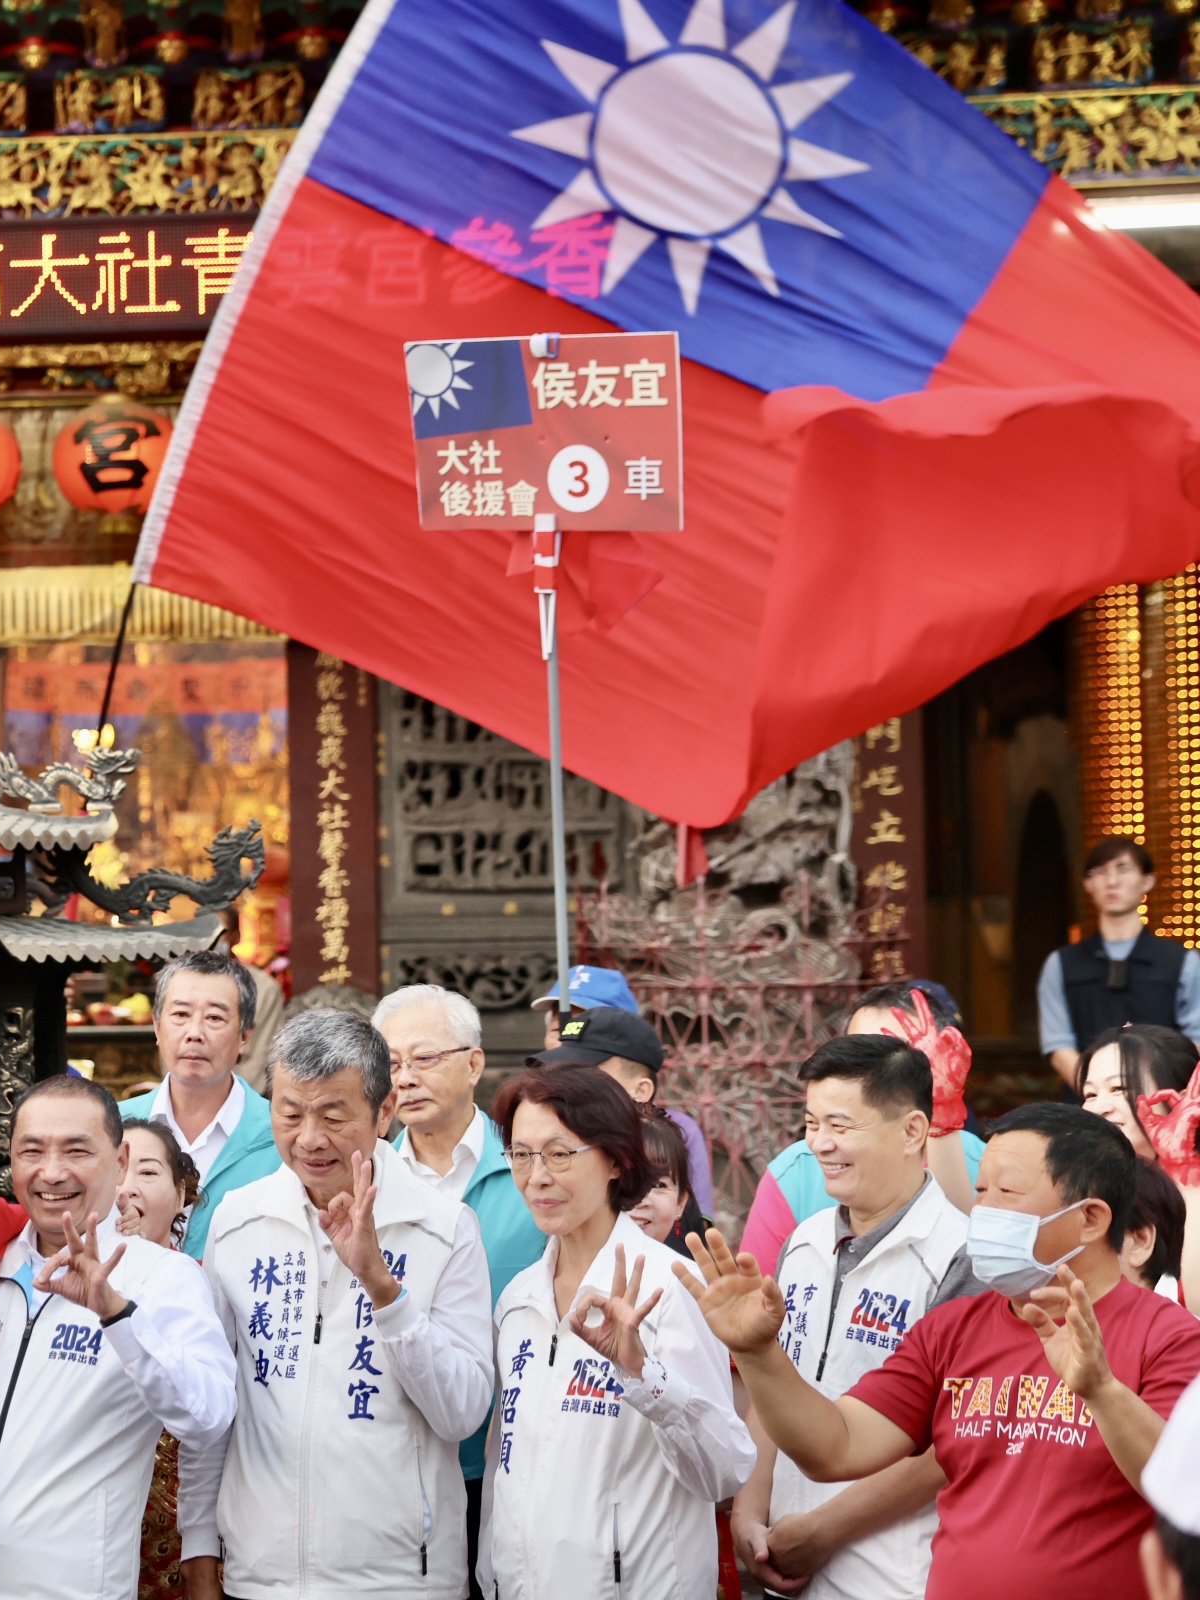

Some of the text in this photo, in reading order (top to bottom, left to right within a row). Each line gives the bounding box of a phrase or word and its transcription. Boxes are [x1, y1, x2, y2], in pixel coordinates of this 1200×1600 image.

[531, 358, 668, 410] 侯友宜
[73, 410, 161, 493] 宮
[437, 439, 503, 476] 大社
[439, 480, 538, 517] 後援會
[567, 456, 665, 501] 3 車
[270, 1252, 294, 1378] 立法委員候選人
[285, 1251, 307, 1379] 高雄市第一選區
[792, 1283, 818, 1366] 市議員
[850, 1287, 911, 1336] 2024
[48, 1350, 98, 1366] 台灣再出發
[51, 1323, 103, 1356] 2024
[348, 1292, 383, 1421] 侯友宜
[566, 1358, 624, 1401] 2024
[560, 1398, 621, 1418] 台灣再出發
[954, 1419, 1087, 1448] HALF MARATHON
